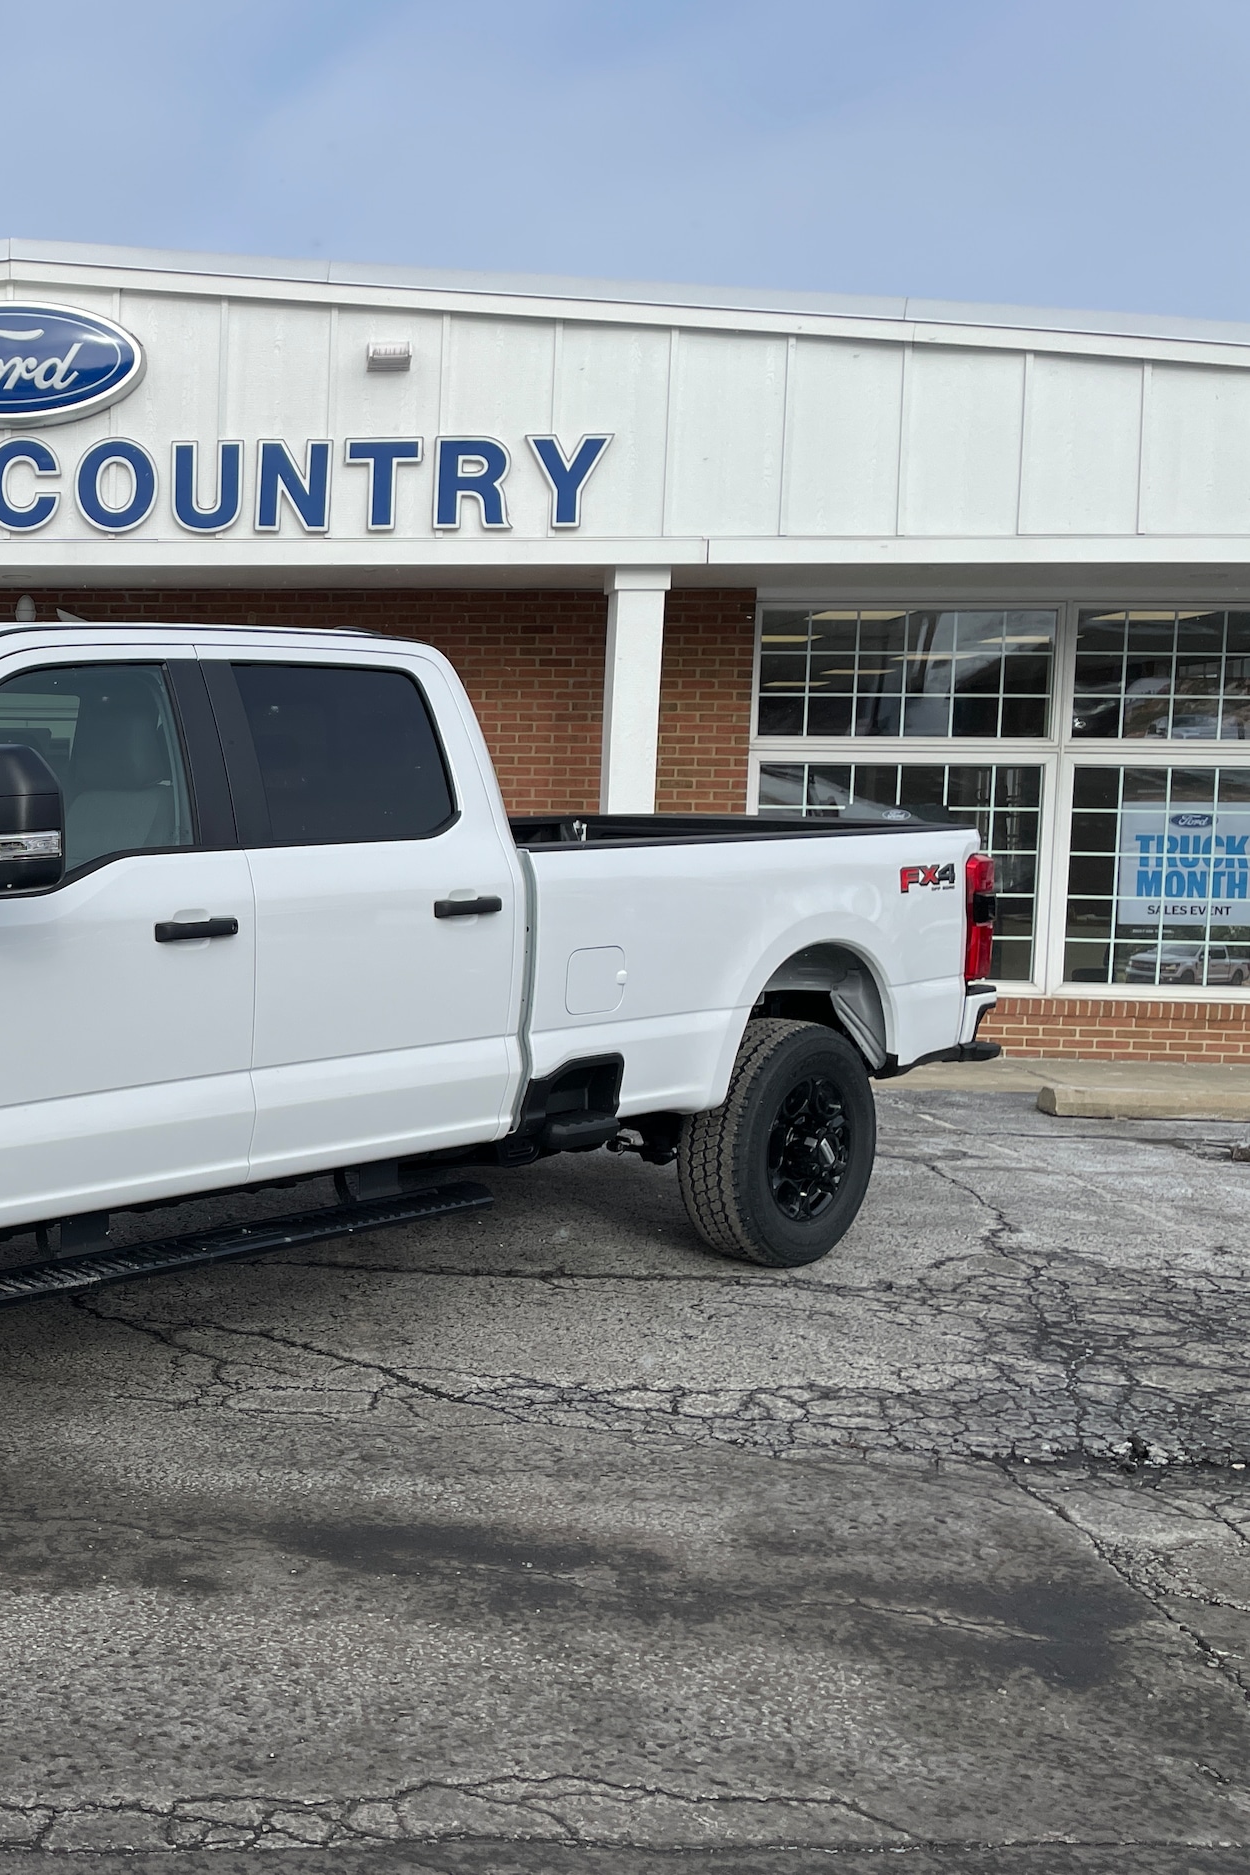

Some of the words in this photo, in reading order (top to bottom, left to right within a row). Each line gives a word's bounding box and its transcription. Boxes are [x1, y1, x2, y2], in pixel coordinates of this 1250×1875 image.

[1178, 814, 1209, 826] Ford
[1135, 834, 1250, 869] TRUCK
[900, 863, 956, 894] FX4
[1136, 870, 1248, 899] MONTH
